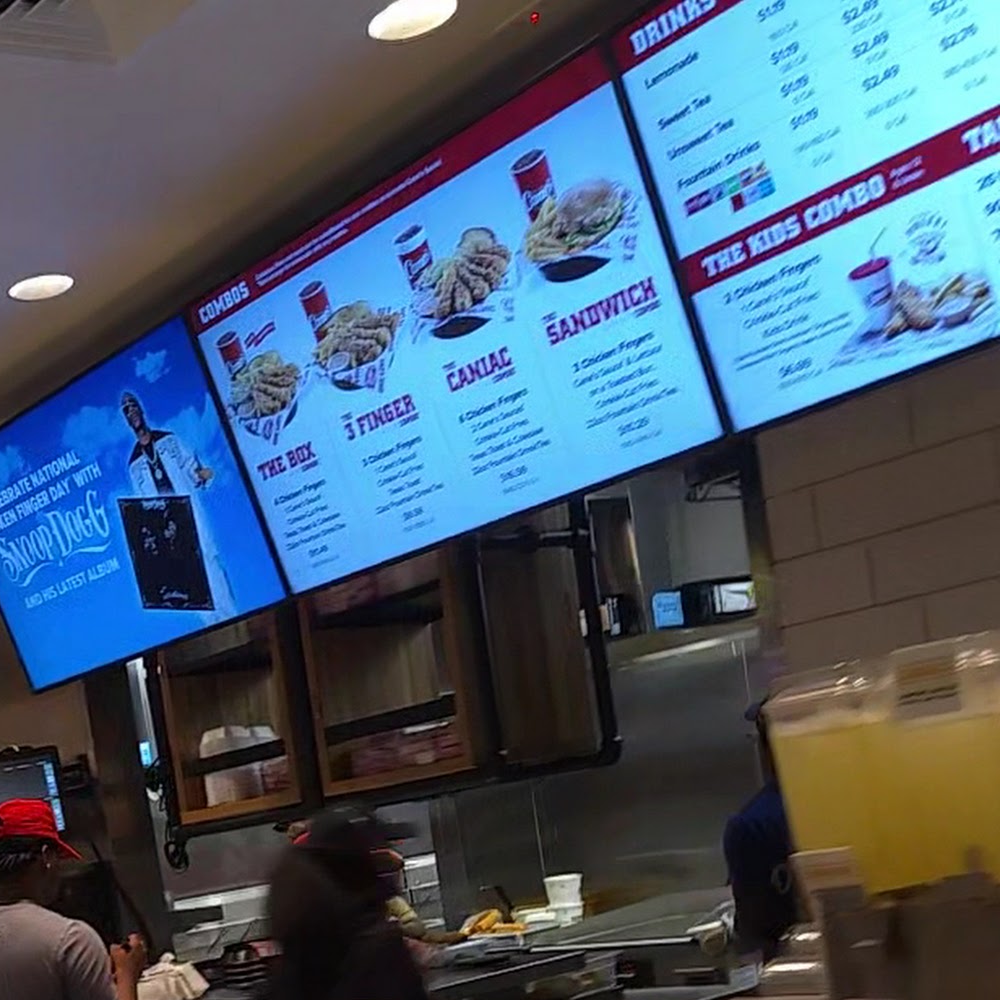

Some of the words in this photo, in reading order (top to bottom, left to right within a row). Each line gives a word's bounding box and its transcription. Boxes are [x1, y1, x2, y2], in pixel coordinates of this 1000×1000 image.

[644, 52, 699, 90] Lemonade
[701, 241, 748, 278] THE
[745, 213, 802, 259] KIDS
[803, 173, 887, 231] COMBO
[198, 280, 251, 325] COMBOS
[545, 275, 658, 346] SANDWICH
[445, 346, 513, 393] CANIAC
[344, 421, 356, 441] 3
[356, 393, 417, 437] FINGER
[29, 449, 81, 488] NATIONAL
[256, 453, 287, 481] THE
[287, 441, 317, 469] BOX
[15, 489, 51, 520] FINGER
[48, 478, 71, 502] DAY
[72, 461, 102, 488] WITH
[24, 592, 43, 609] AND
[40, 585, 58, 602] HIS
[55, 571, 88, 596] LATEST
[86, 556, 121, 581] ALBUM
